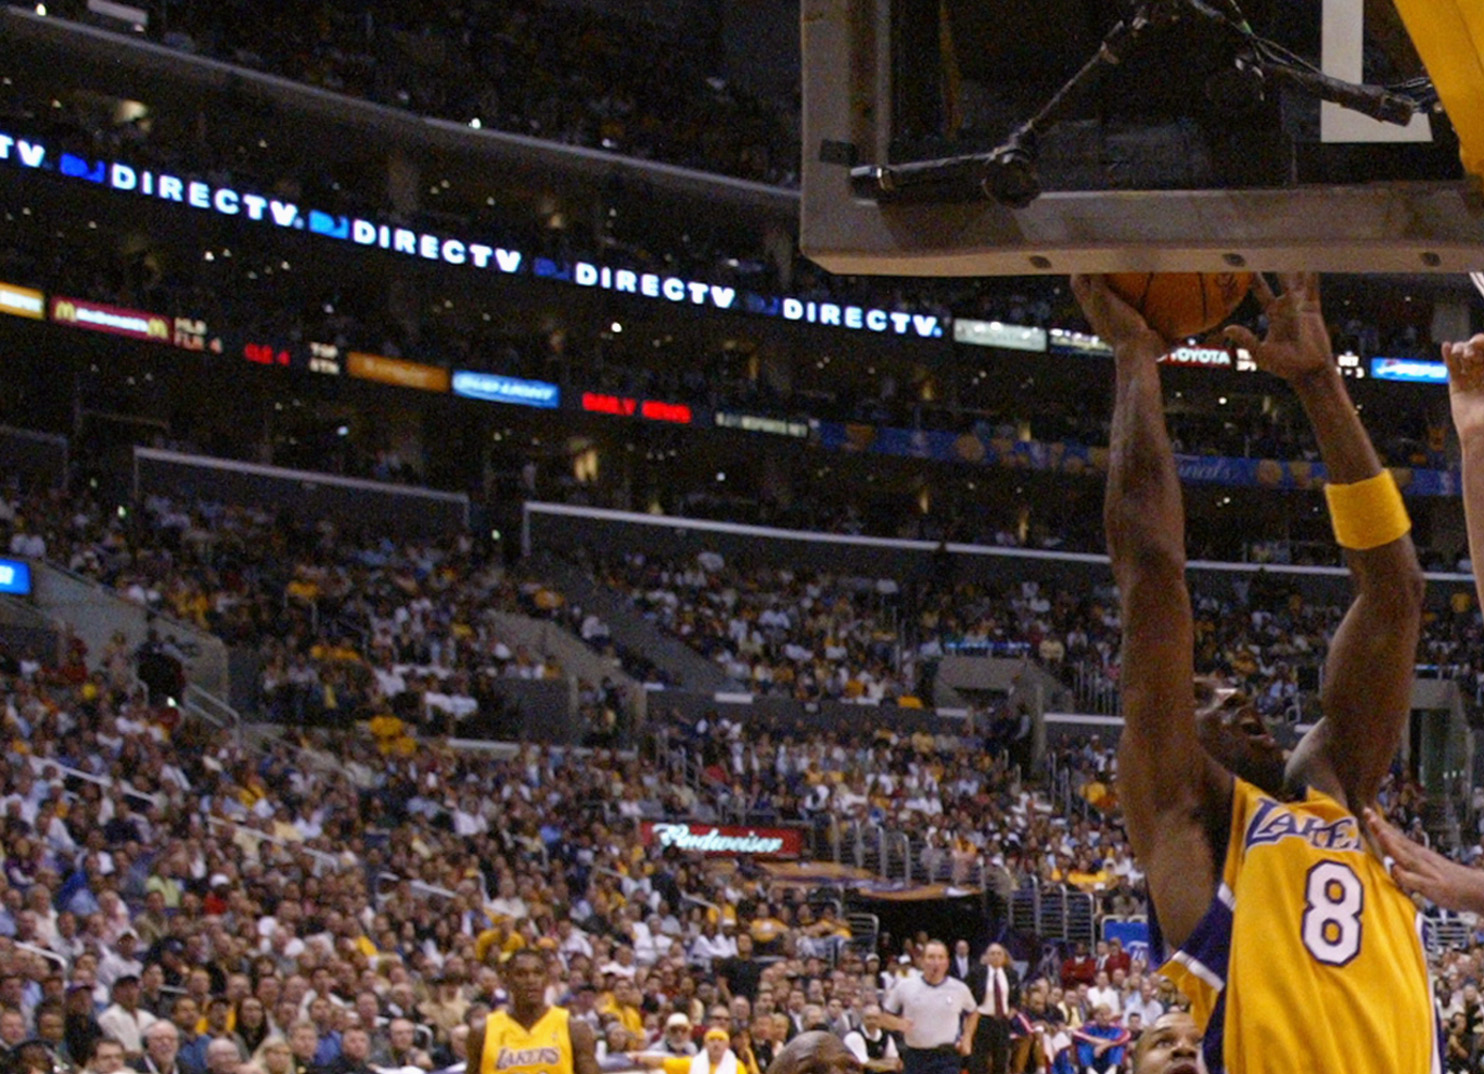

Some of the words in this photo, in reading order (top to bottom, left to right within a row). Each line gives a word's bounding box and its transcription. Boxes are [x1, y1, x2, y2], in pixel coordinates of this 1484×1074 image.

[111, 162, 299, 229] DIRECTV
[353, 218, 521, 274] DIRECTV
[575, 261, 735, 309] DIRECTV
[783, 298, 937, 338] DIRECTV
[652, 823, 784, 853] Budweiser
[1245, 797, 1365, 855] LAKE
[1301, 858, 1364, 968] 8
[496, 1047, 560, 1071] LAKERS
